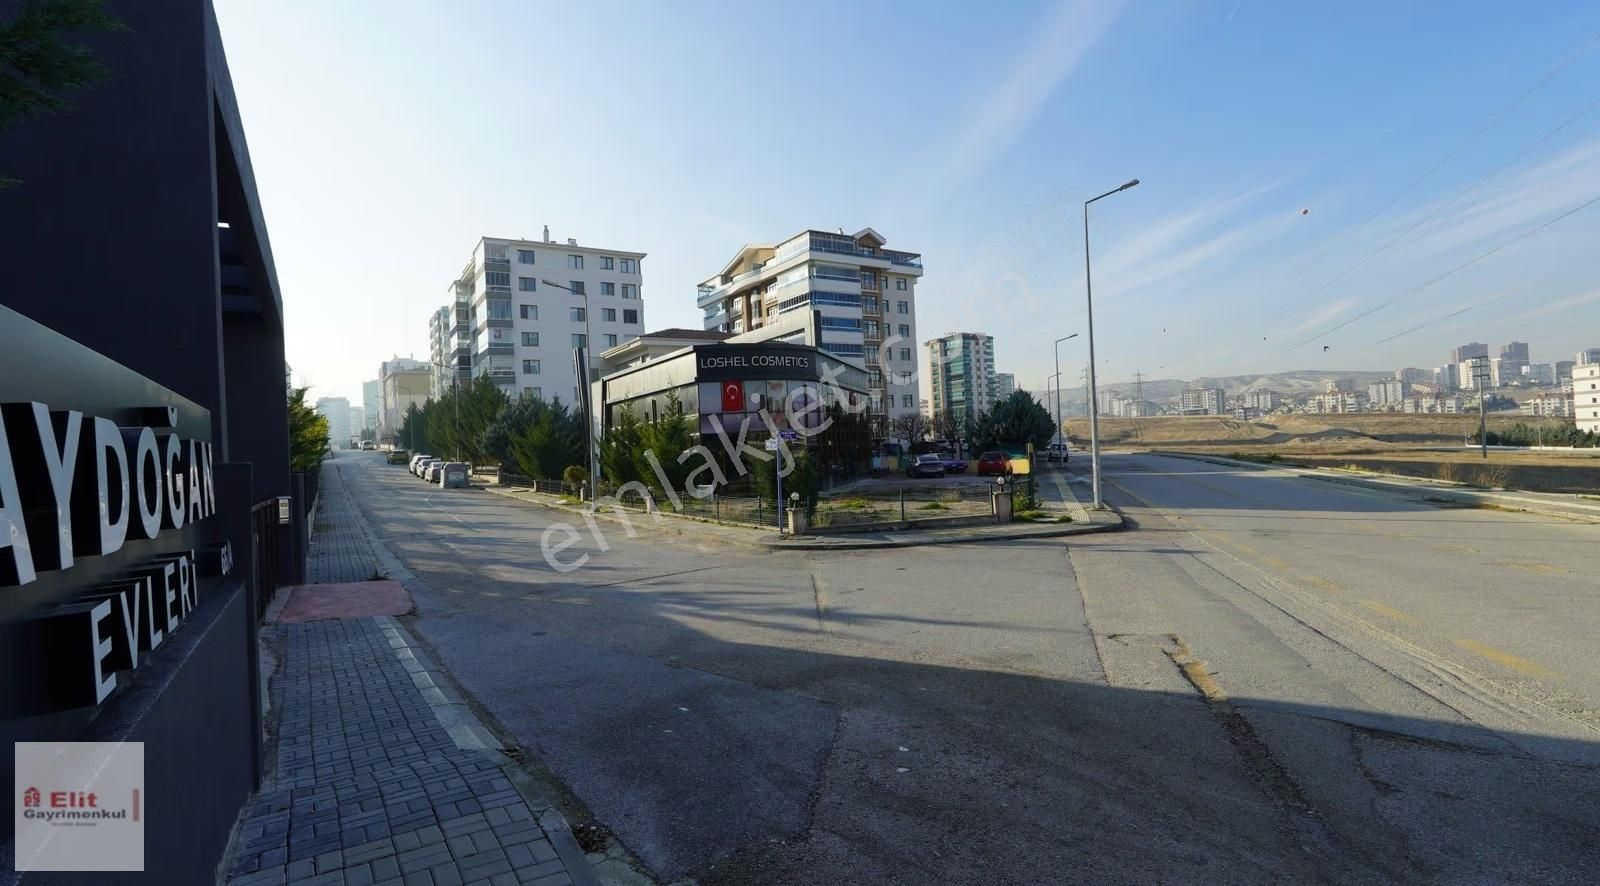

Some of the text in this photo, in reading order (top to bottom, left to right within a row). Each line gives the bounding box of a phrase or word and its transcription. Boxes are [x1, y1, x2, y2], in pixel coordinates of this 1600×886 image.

[701, 355, 808, 369] LOSHEL COSMETICS
[91, 549, 198, 705] EVLERİ
